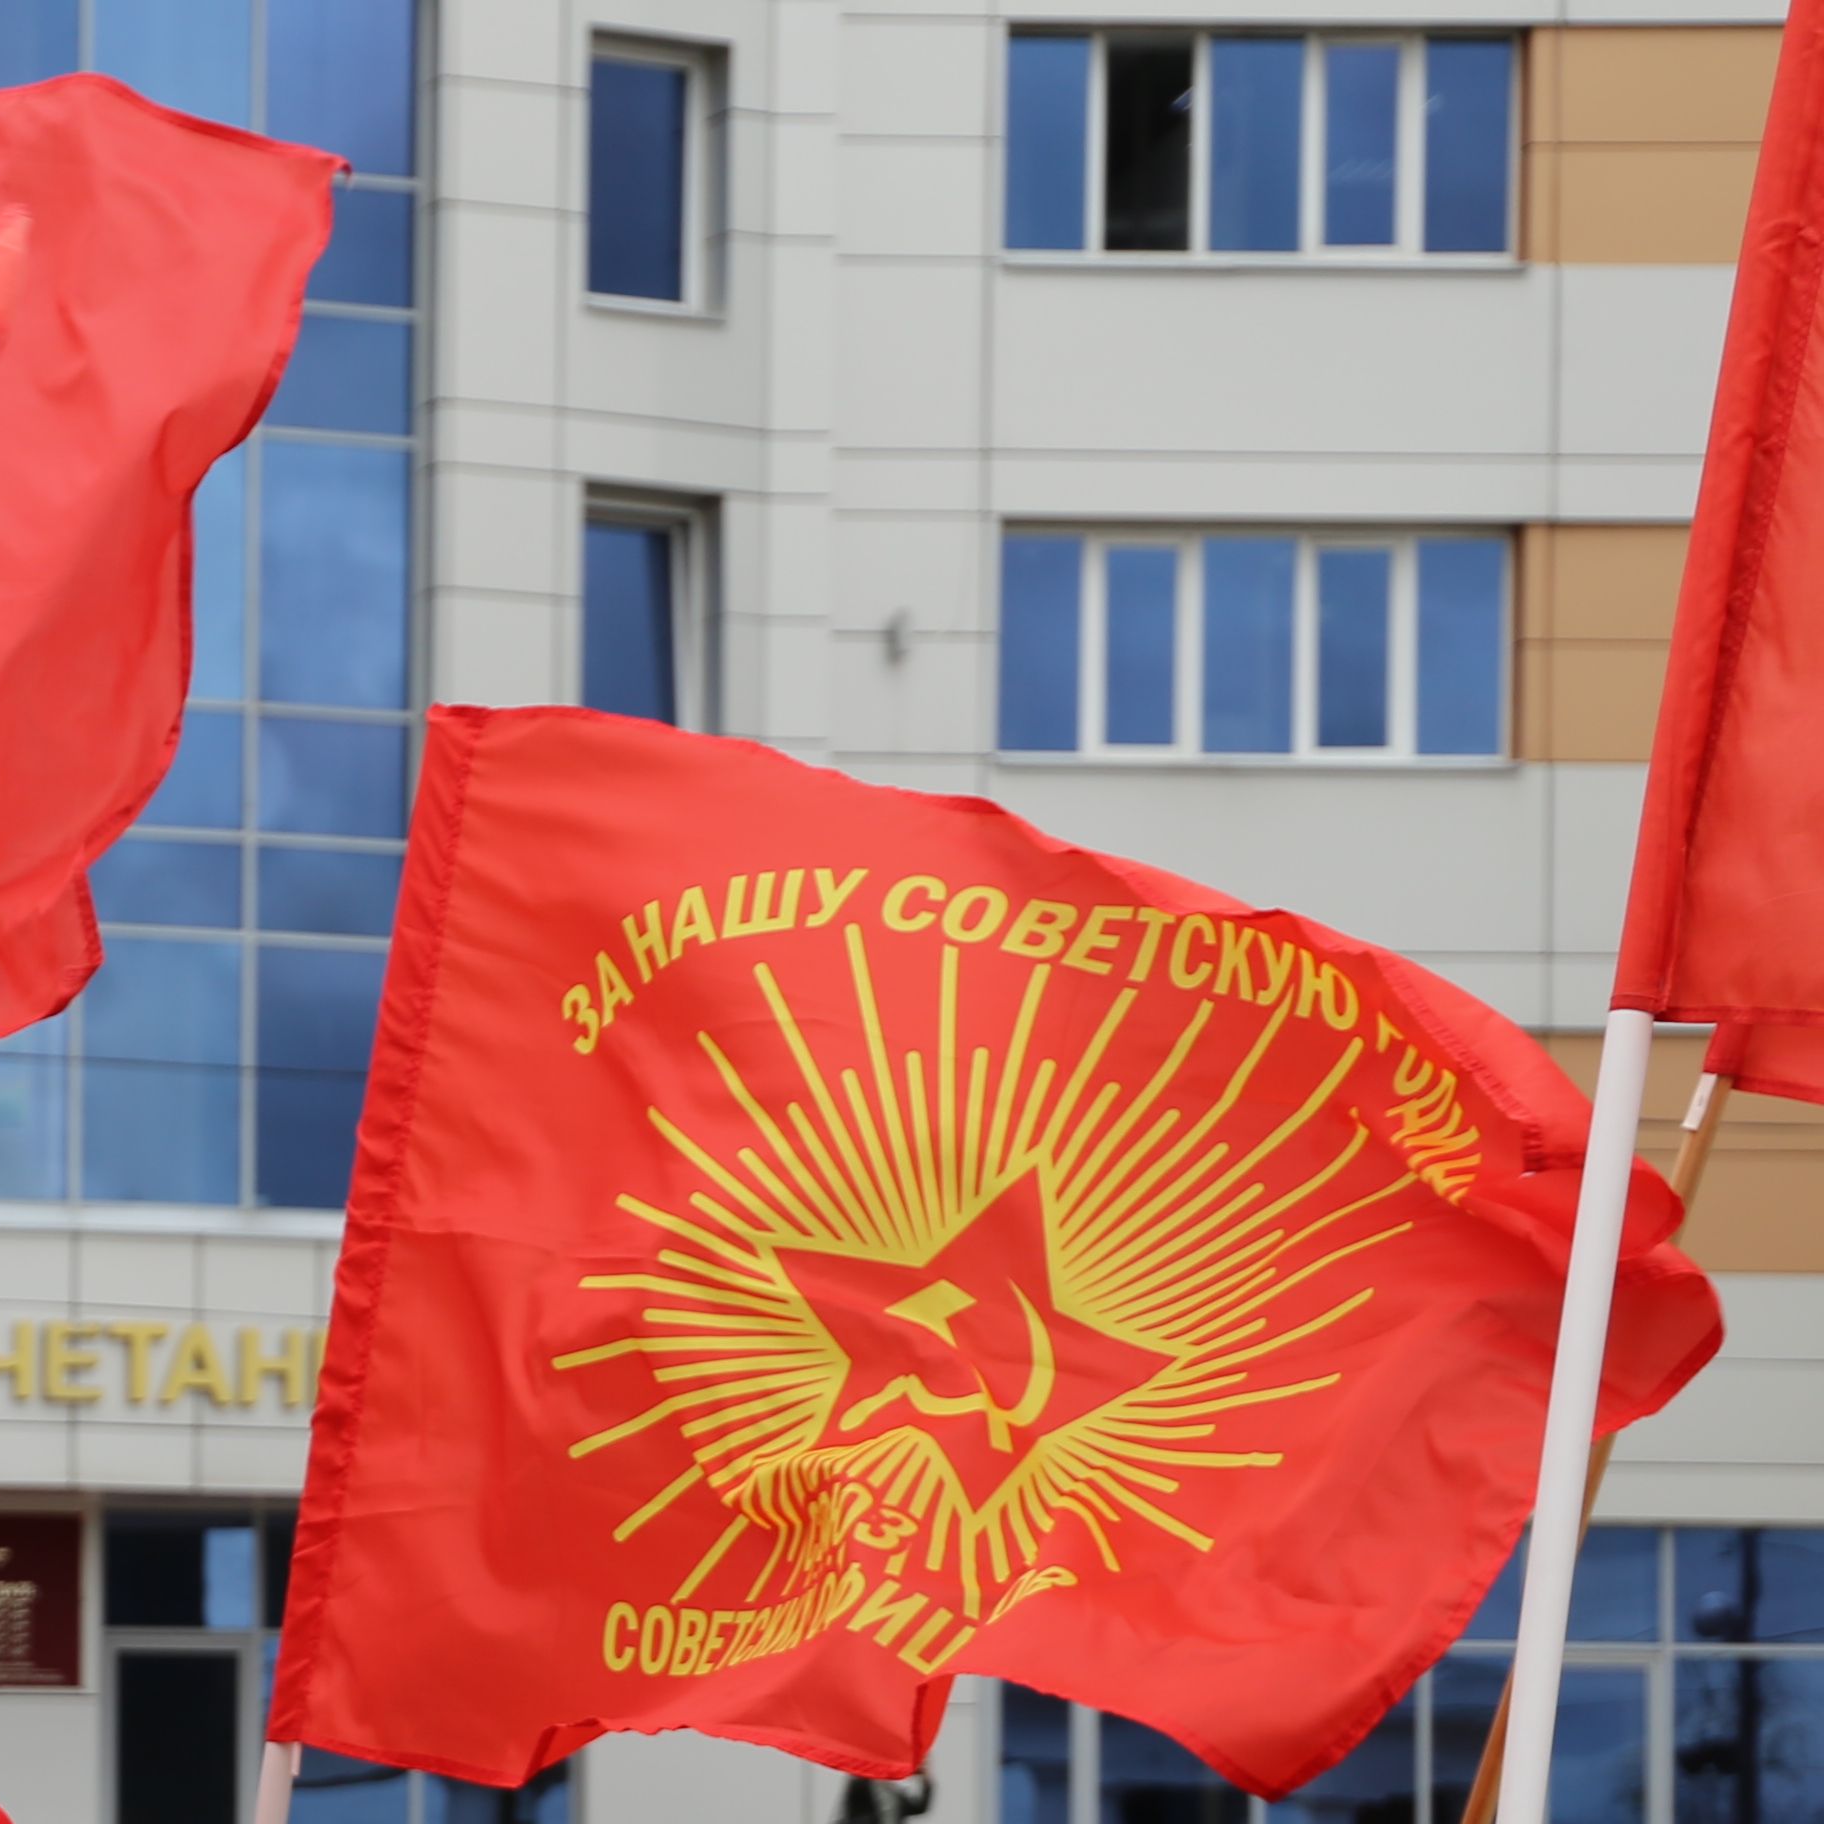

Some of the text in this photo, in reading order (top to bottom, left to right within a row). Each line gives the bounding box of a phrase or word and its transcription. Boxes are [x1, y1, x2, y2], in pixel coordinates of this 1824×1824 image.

[562, 950, 635, 1055] ЗА
[621, 867, 870, 985] НАШУ
[881, 874, 1360, 1031] СОВЕТСКУЮ
